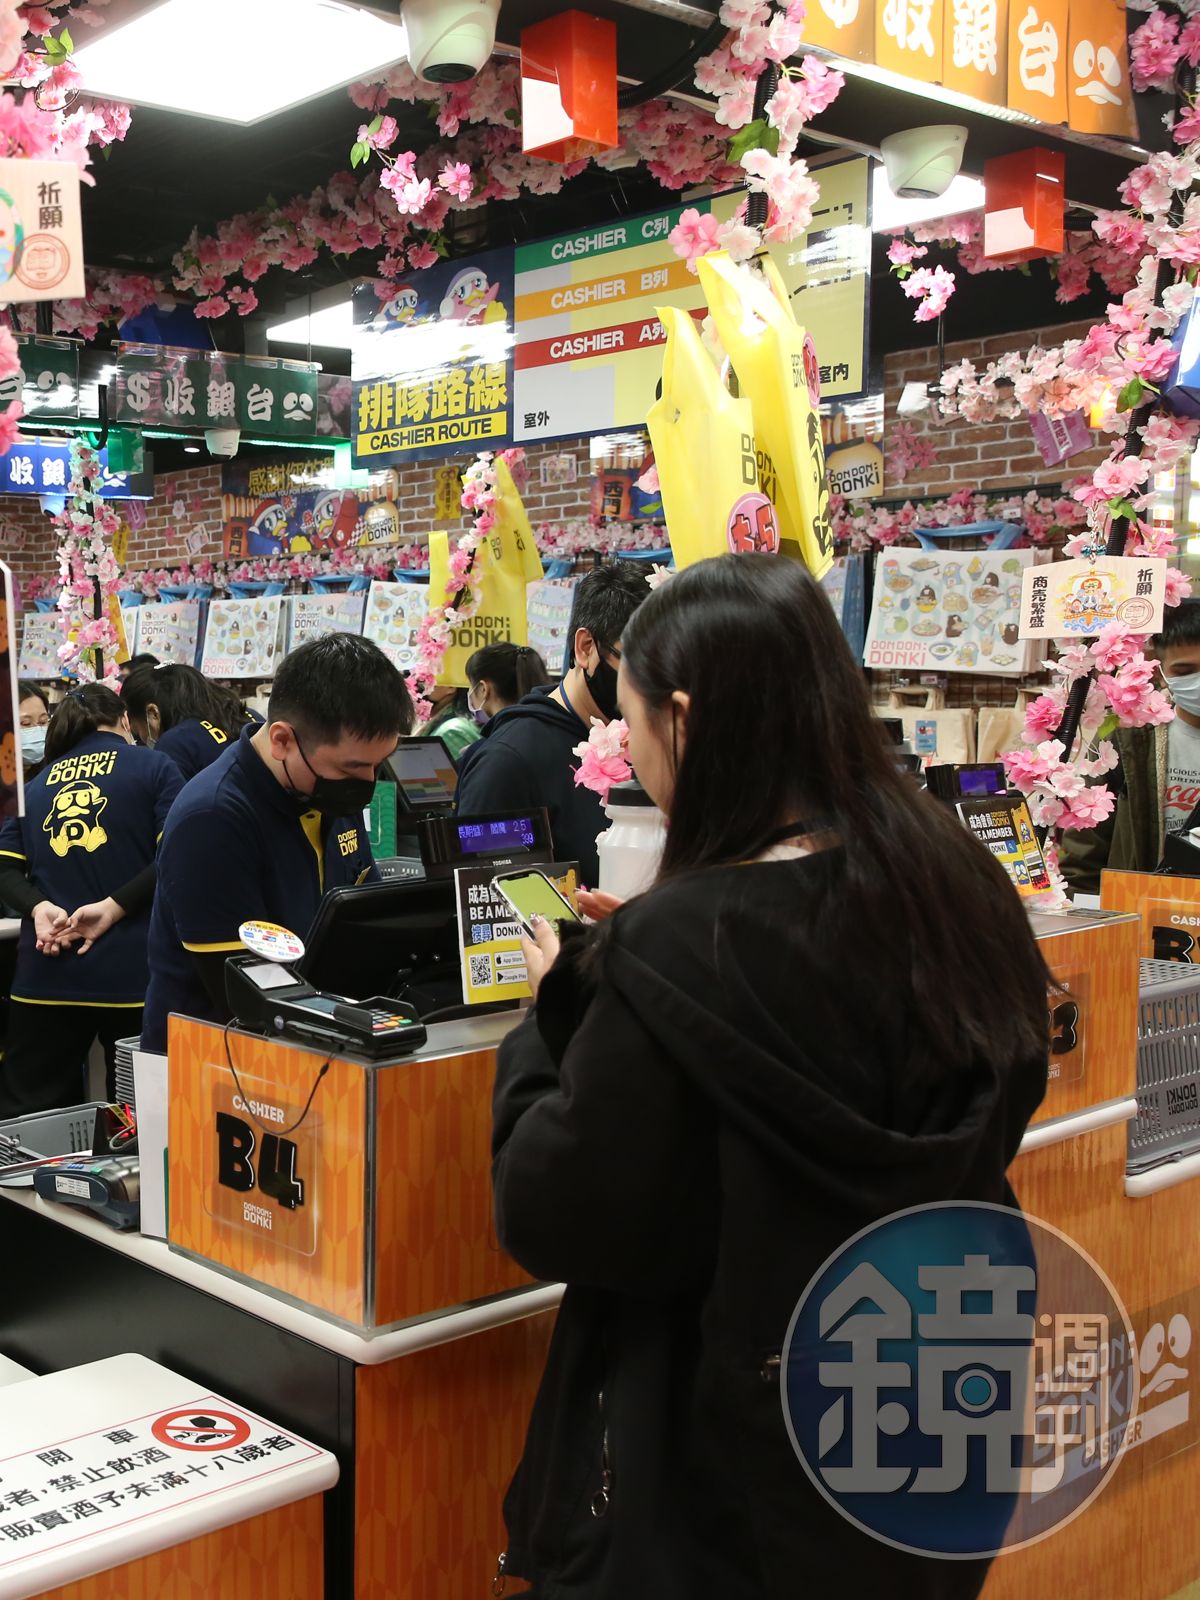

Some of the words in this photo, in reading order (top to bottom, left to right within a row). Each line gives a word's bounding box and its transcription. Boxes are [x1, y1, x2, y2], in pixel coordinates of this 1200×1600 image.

[37, 181, 63, 229] 祈願
[551, 227, 627, 260] CASHIER
[642, 216, 669, 239] C列
[551, 279, 626, 309] CASHIER
[640, 268, 668, 291] B列
[550, 330, 624, 358] CASHIER
[639, 322, 667, 343] A列
[165, 378, 274, 421] 收銀台
[358, 361, 508, 431] 排隊路線
[524, 411, 550, 429] 室外
[371, 427, 434, 450] CASHIER
[439, 418, 492, 440] ROUTE
[831, 471, 880, 495] DONKI
[368, 524, 397, 541] DONKI
[1136, 568, 1153, 596] 祈願
[1029, 576, 1048, 628] 商売繁盛
[142, 626, 166, 635] DONKI
[295, 619, 320, 628] DONKI
[203, 665, 234, 674] DONKI
[869, 650, 926, 665] DONKI
[46, 760, 117, 785] DONKI
[51, 756, 78, 772] DON
[80, 752, 109, 764] DON
[987, 827, 1013, 839] MEMBER
[470, 906, 484, 920] BE
[485, 905, 494, 919] A
[1166, 1083, 1197, 1105] DONKI
[232, 1095, 285, 1124] CASHIER
[216, 1111, 304, 1210] B4
[243, 1210, 272, 1230] DONKI
